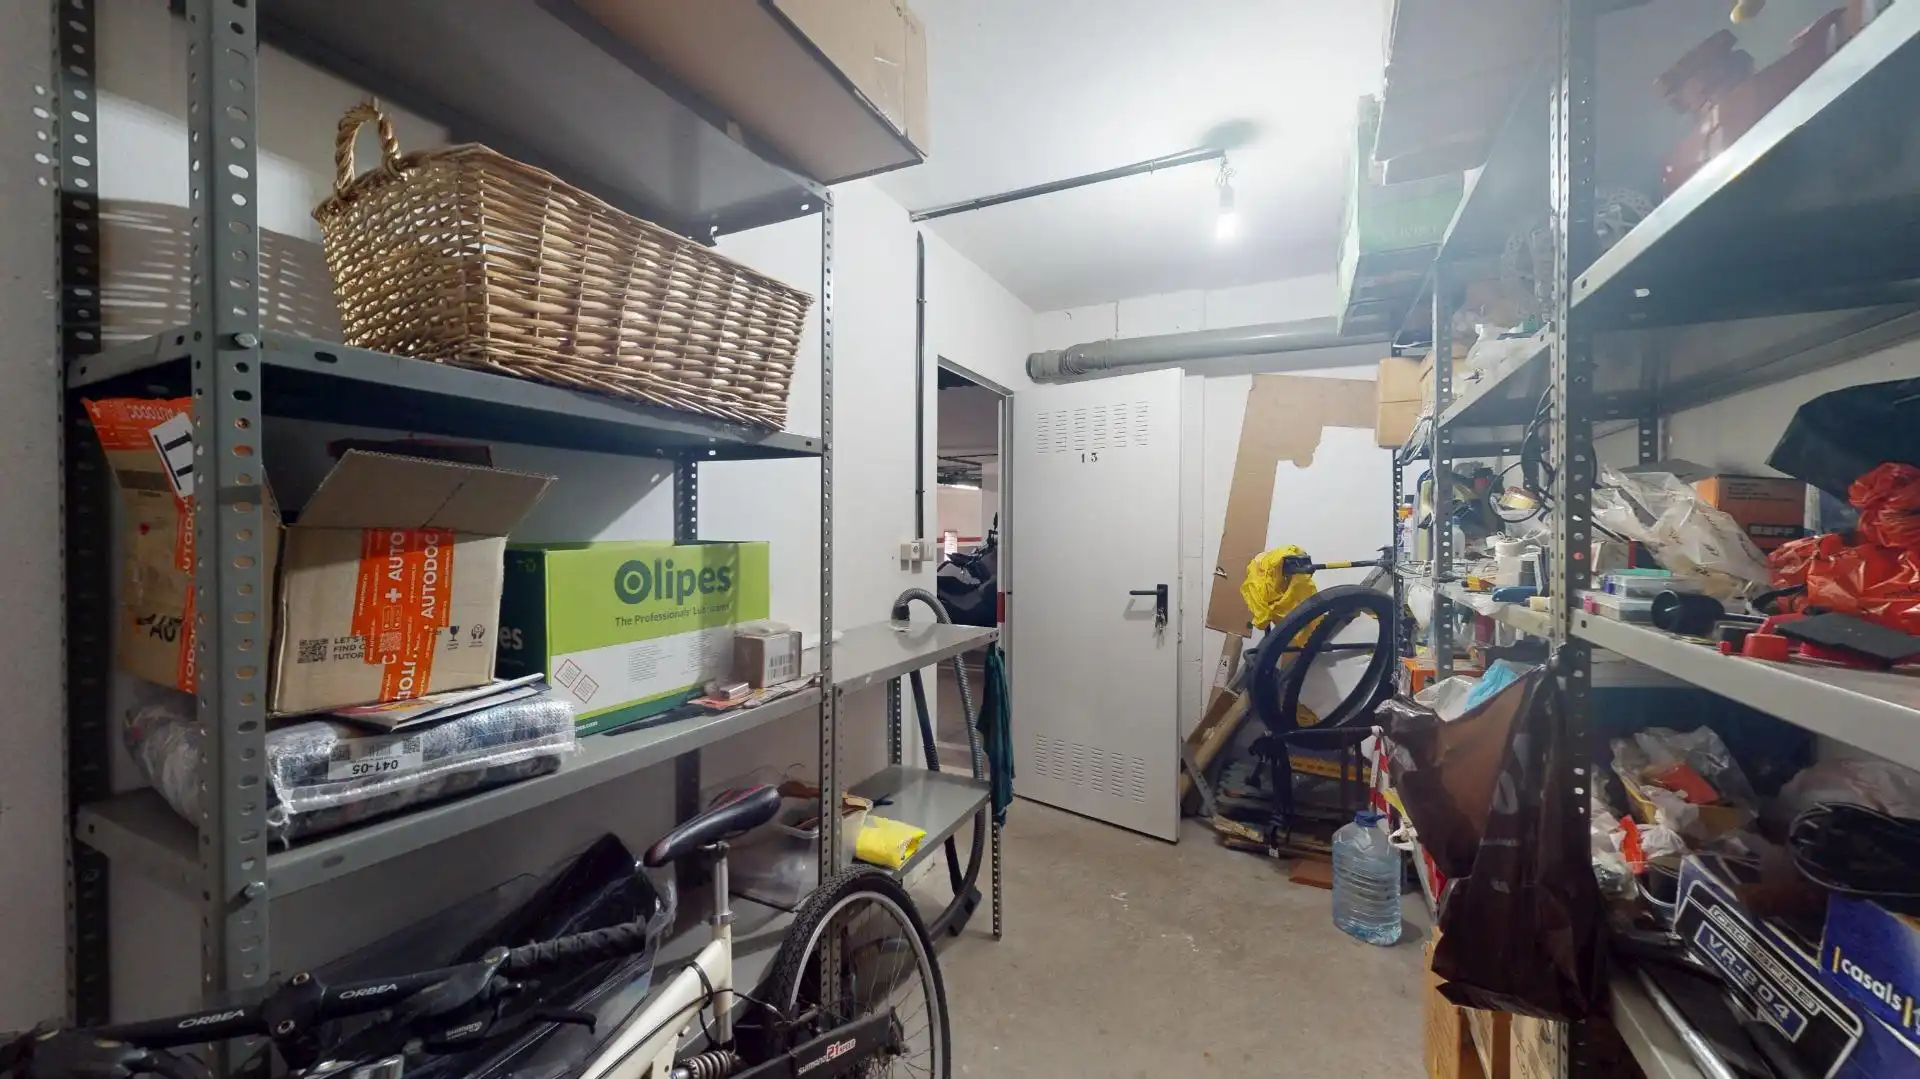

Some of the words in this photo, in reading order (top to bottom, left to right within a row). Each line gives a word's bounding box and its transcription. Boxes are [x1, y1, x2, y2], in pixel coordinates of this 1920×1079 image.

[421, 533, 439, 619] AUTODOC
[614, 558, 732, 606] Olipes
[615, 616, 633, 628] The
[339, 983, 398, 1000] ORBEA
[1709, 933, 1791, 1020] VR-804
[1841, 958, 1902, 1012] casals
[177, 1008, 245, 1030] ORBEA
